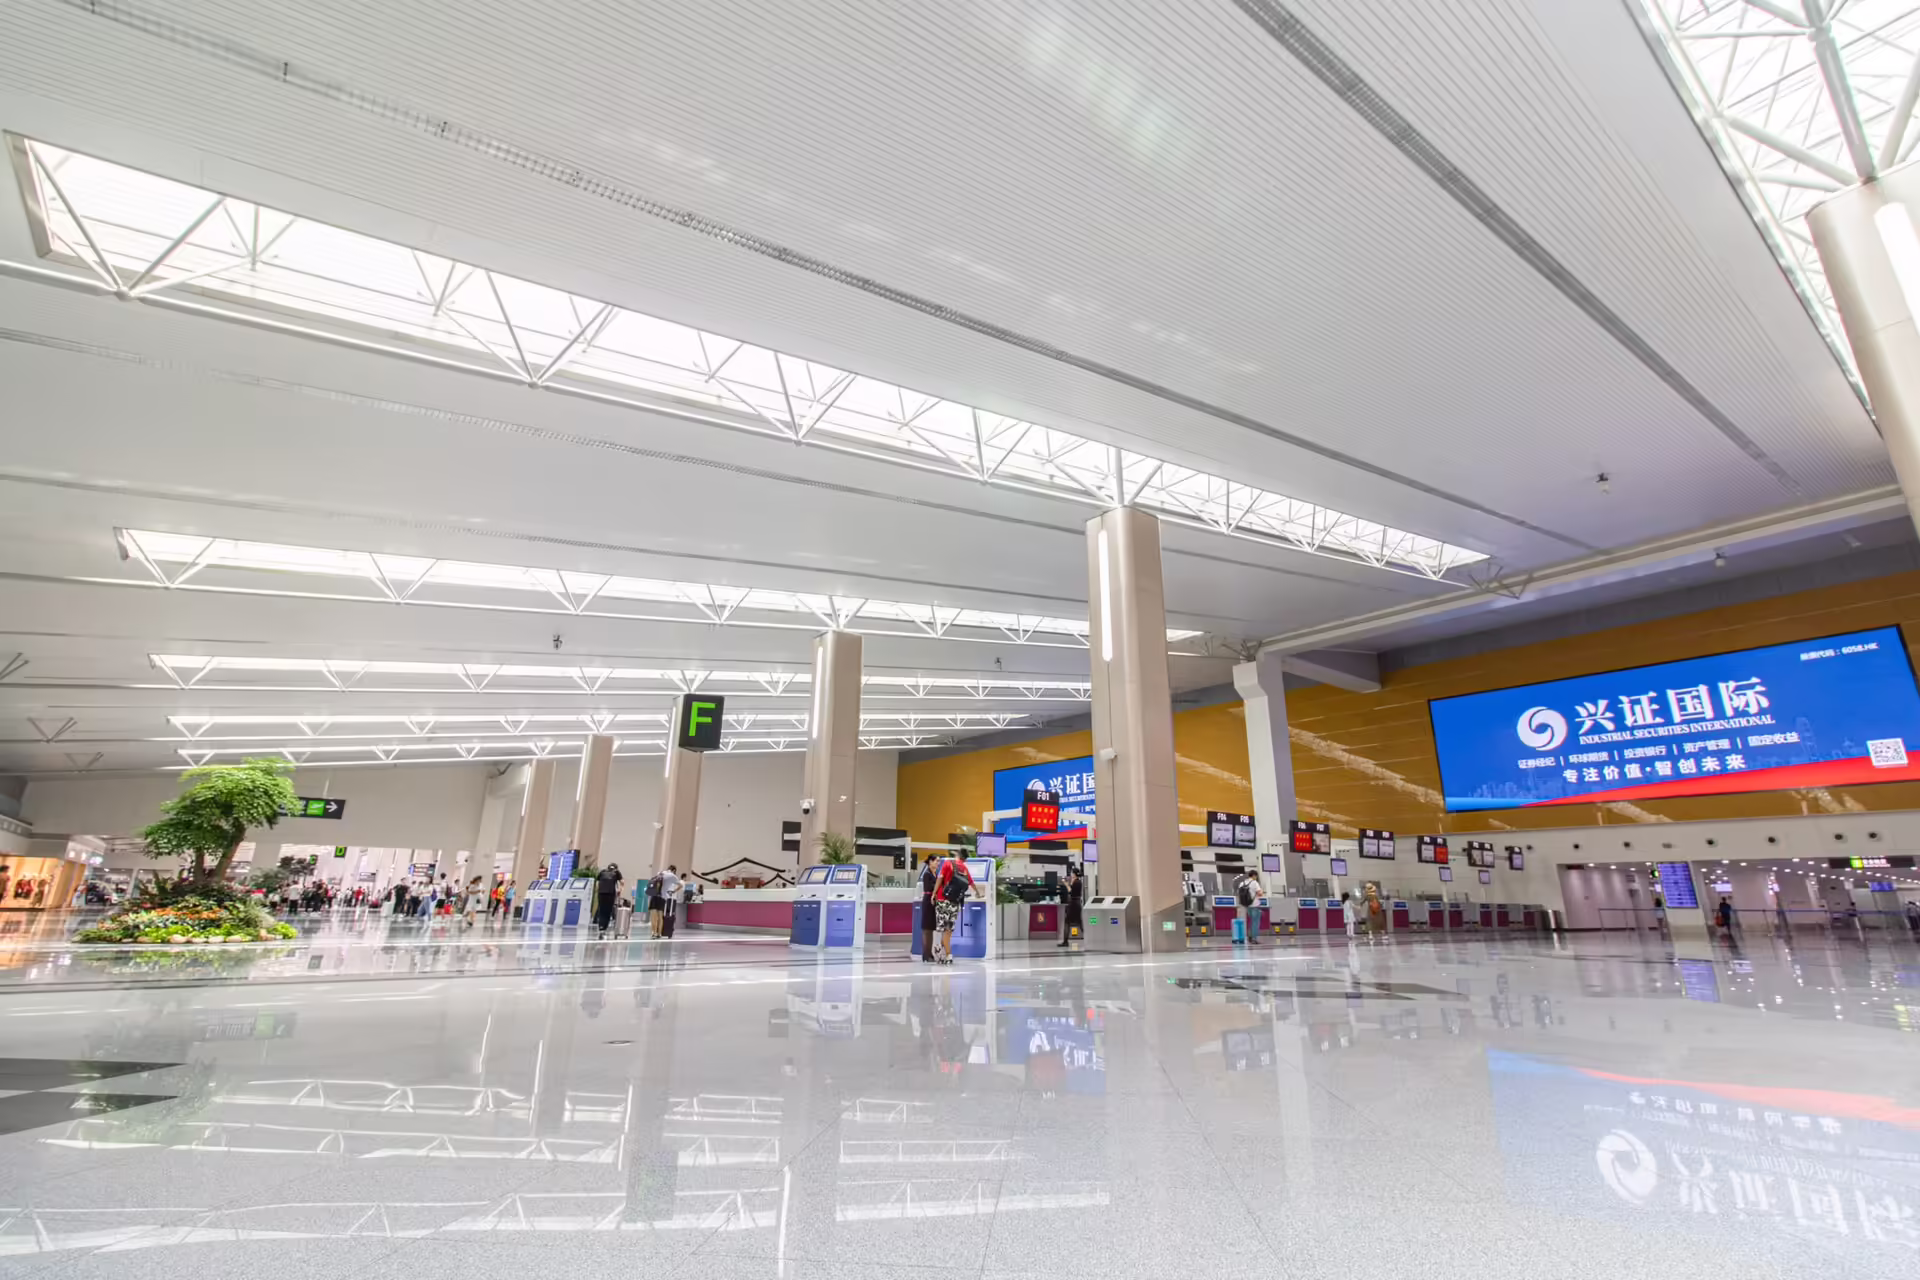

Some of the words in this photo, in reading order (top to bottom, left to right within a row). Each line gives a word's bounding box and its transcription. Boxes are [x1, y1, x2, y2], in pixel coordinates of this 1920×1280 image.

[688, 701, 716, 736] F
[1574, 676, 1770, 735] 兴证国际
[1579, 732, 1632, 745] INDUSTRIAL
[1634, 724, 1690, 739] SECURITIES
[1691, 714, 1776, 733] INTERNATIONAL
[1037, 791, 1050, 801] F01
[335, 846, 345, 856] D
